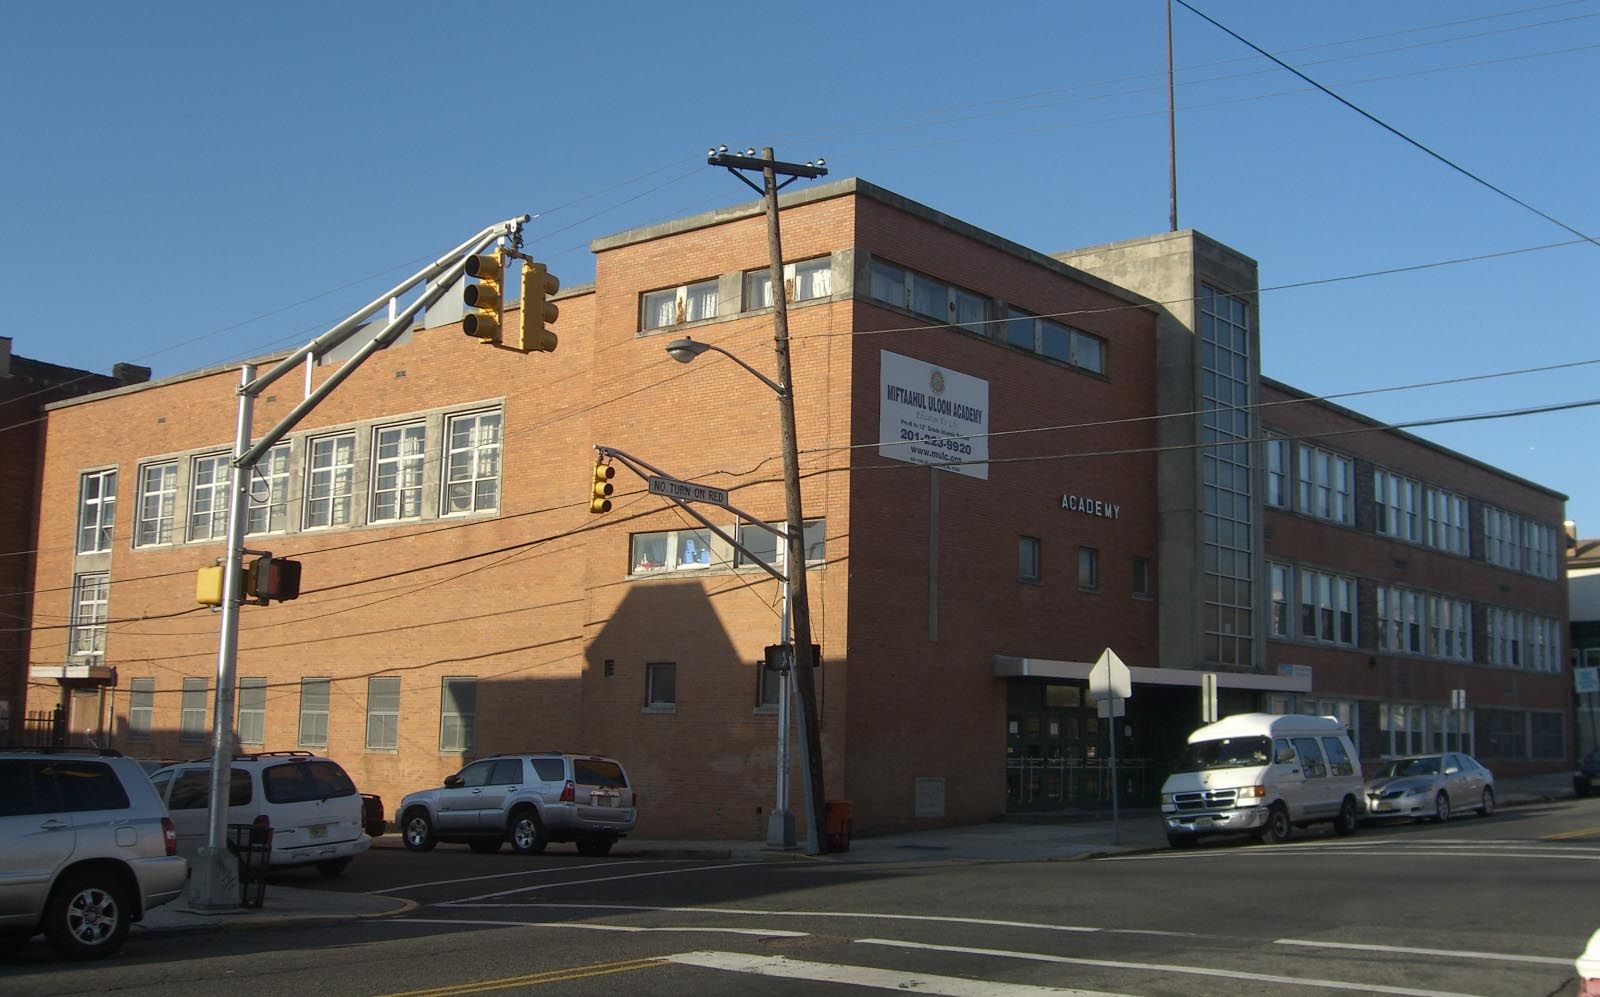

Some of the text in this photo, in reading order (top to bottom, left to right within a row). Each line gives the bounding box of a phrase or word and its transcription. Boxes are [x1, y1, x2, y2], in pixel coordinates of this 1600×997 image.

[887, 384, 926, 410] MIFTAAHUL
[928, 395, 952, 417] ULOOM
[953, 403, 983, 425] ACADEMY
[900, 428, 972, 455] 201-223-9920
[654, 481, 724, 503] NO TURN ON RED
[1062, 494, 1120, 519] ACADEMY
